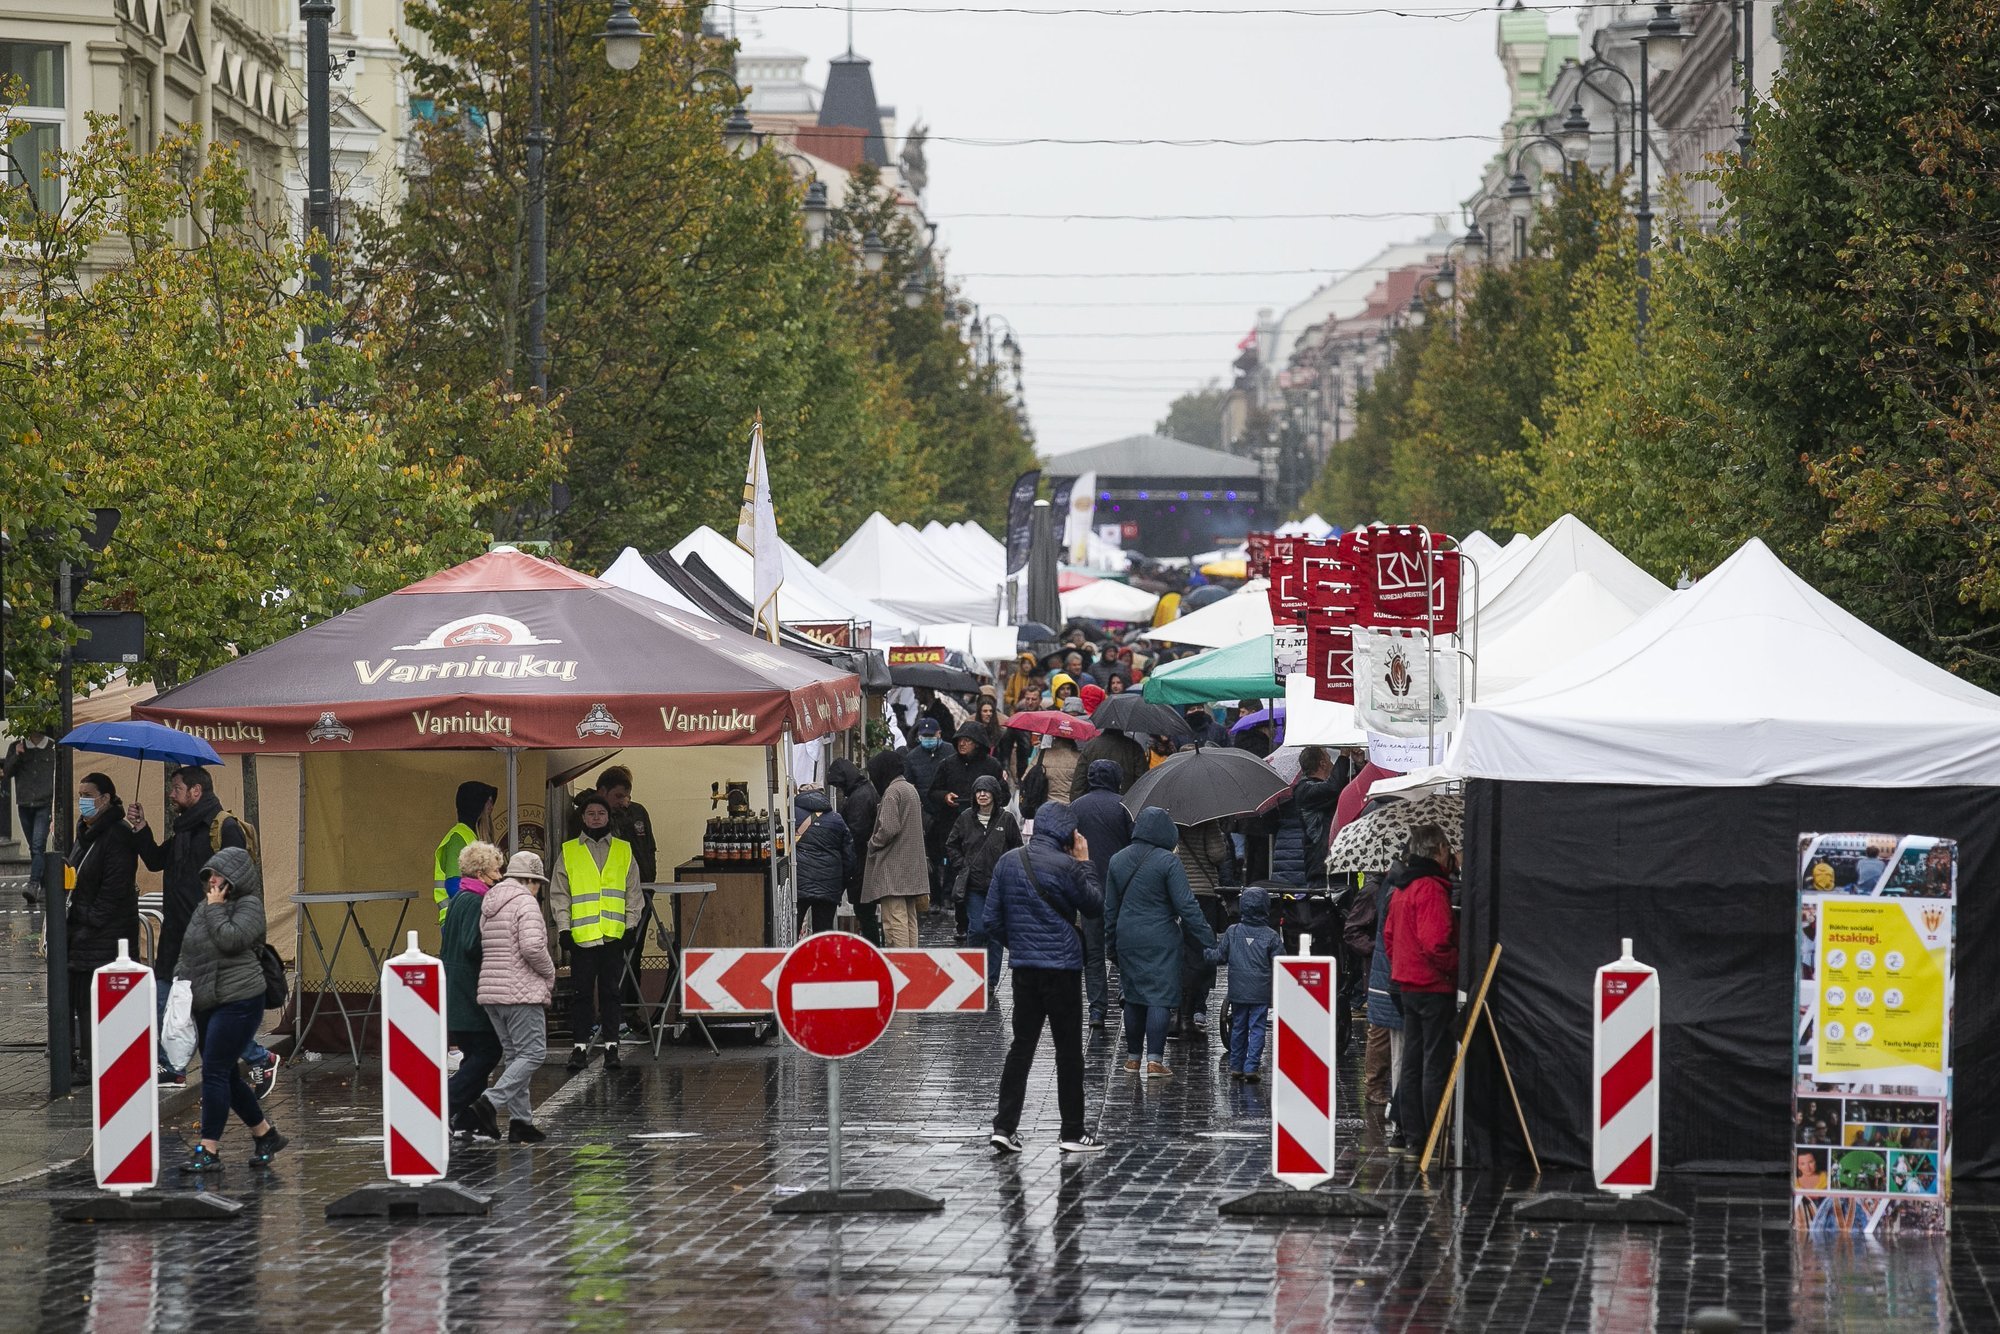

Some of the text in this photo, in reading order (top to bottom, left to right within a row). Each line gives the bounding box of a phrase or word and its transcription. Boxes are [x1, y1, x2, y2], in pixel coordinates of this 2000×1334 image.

[890, 652, 941, 663] KAVA
[1383, 642, 1411, 670] KELMAS
[353, 654, 579, 685] Varniukų
[163, 718, 266, 744] Varniukų
[412, 710, 513, 737] Varniukų
[659, 706, 758, 735] Varniukų
[1828, 933, 1882, 945] atsakingi.
[1923, 1041, 1939, 1049] 2021
